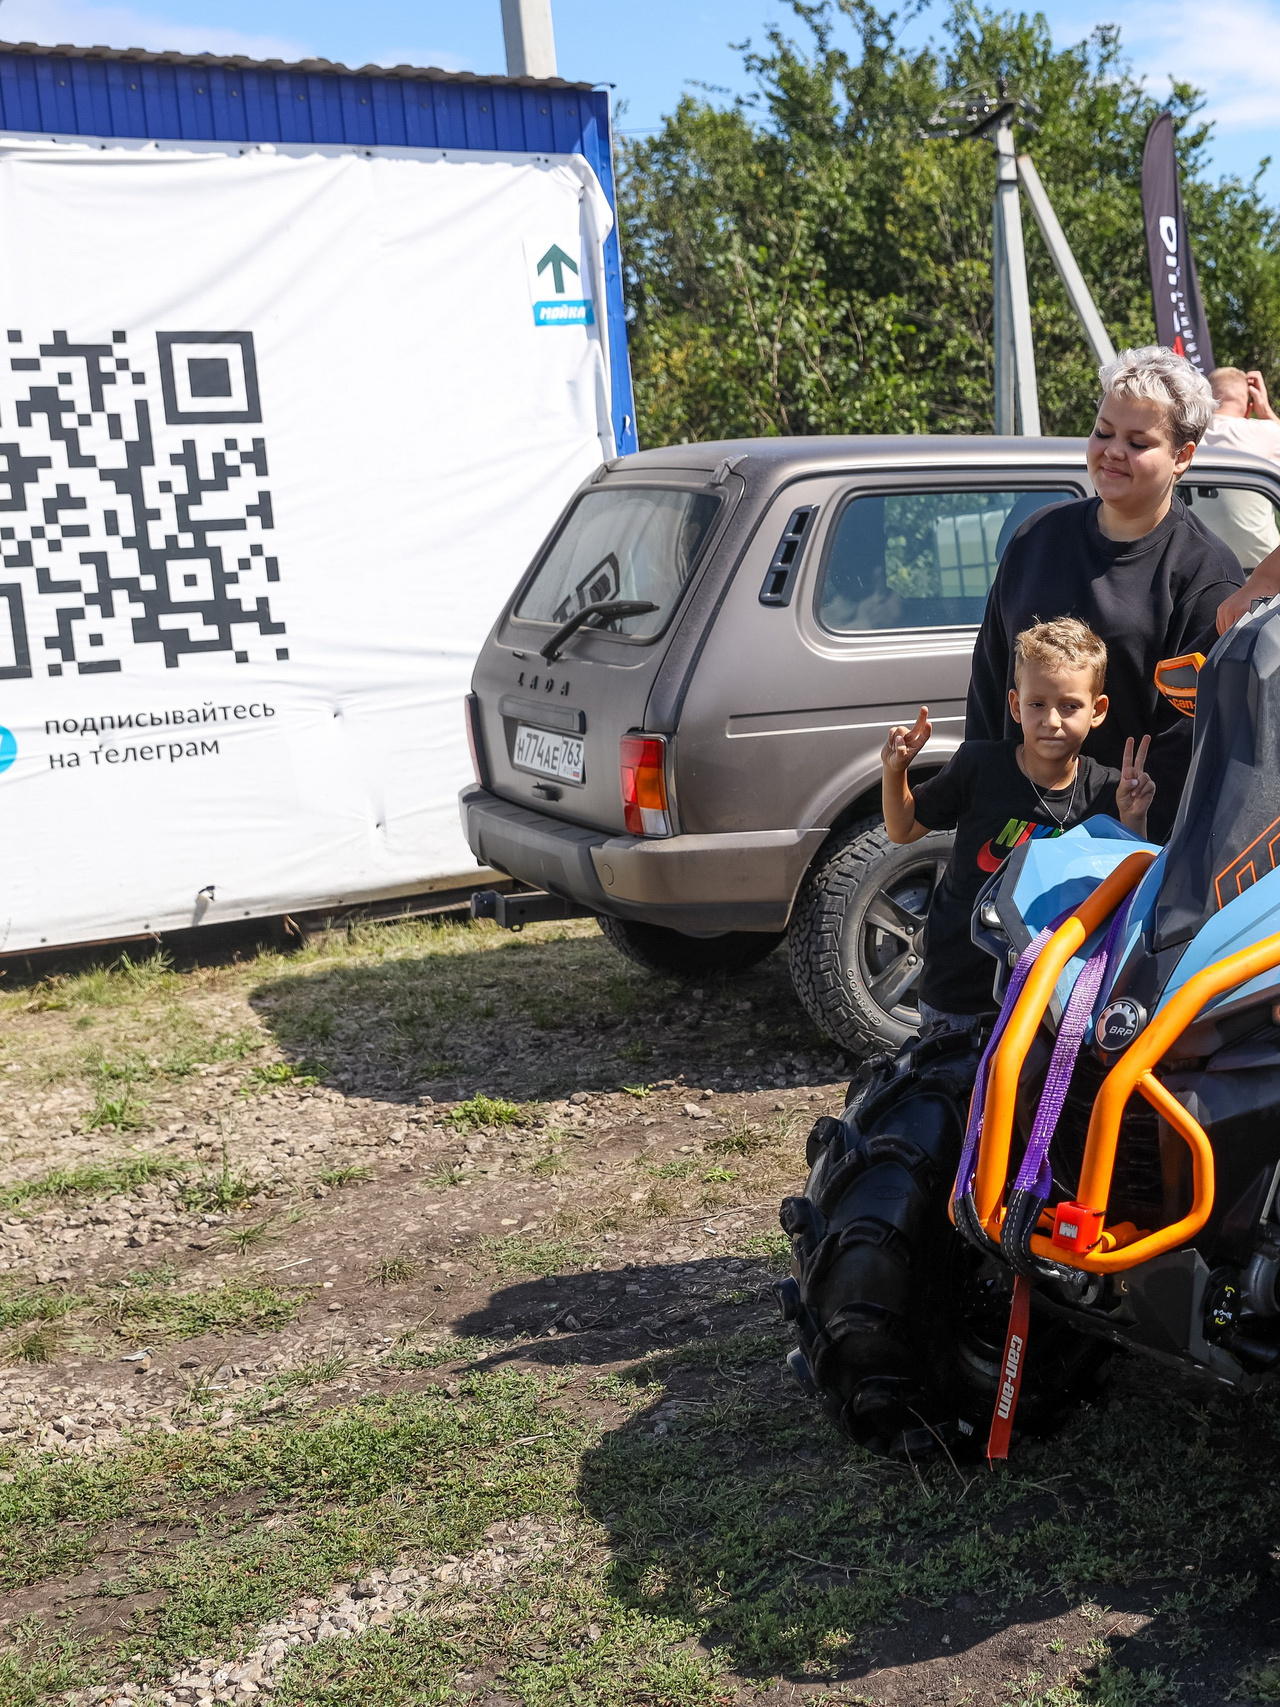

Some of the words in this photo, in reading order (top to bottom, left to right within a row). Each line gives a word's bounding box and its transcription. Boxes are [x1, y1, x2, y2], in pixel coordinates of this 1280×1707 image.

[540, 304, 587, 320] МОЙКА
[517, 672, 570, 696] LADA
[45, 702, 276, 736] подписывайтесь
[49, 752, 81, 769] на
[90, 739, 220, 763] телеграм
[561, 740, 581, 767] 763
[1109, 1025, 1133, 1037] BRP
[998, 1334, 1024, 1420] can-am
